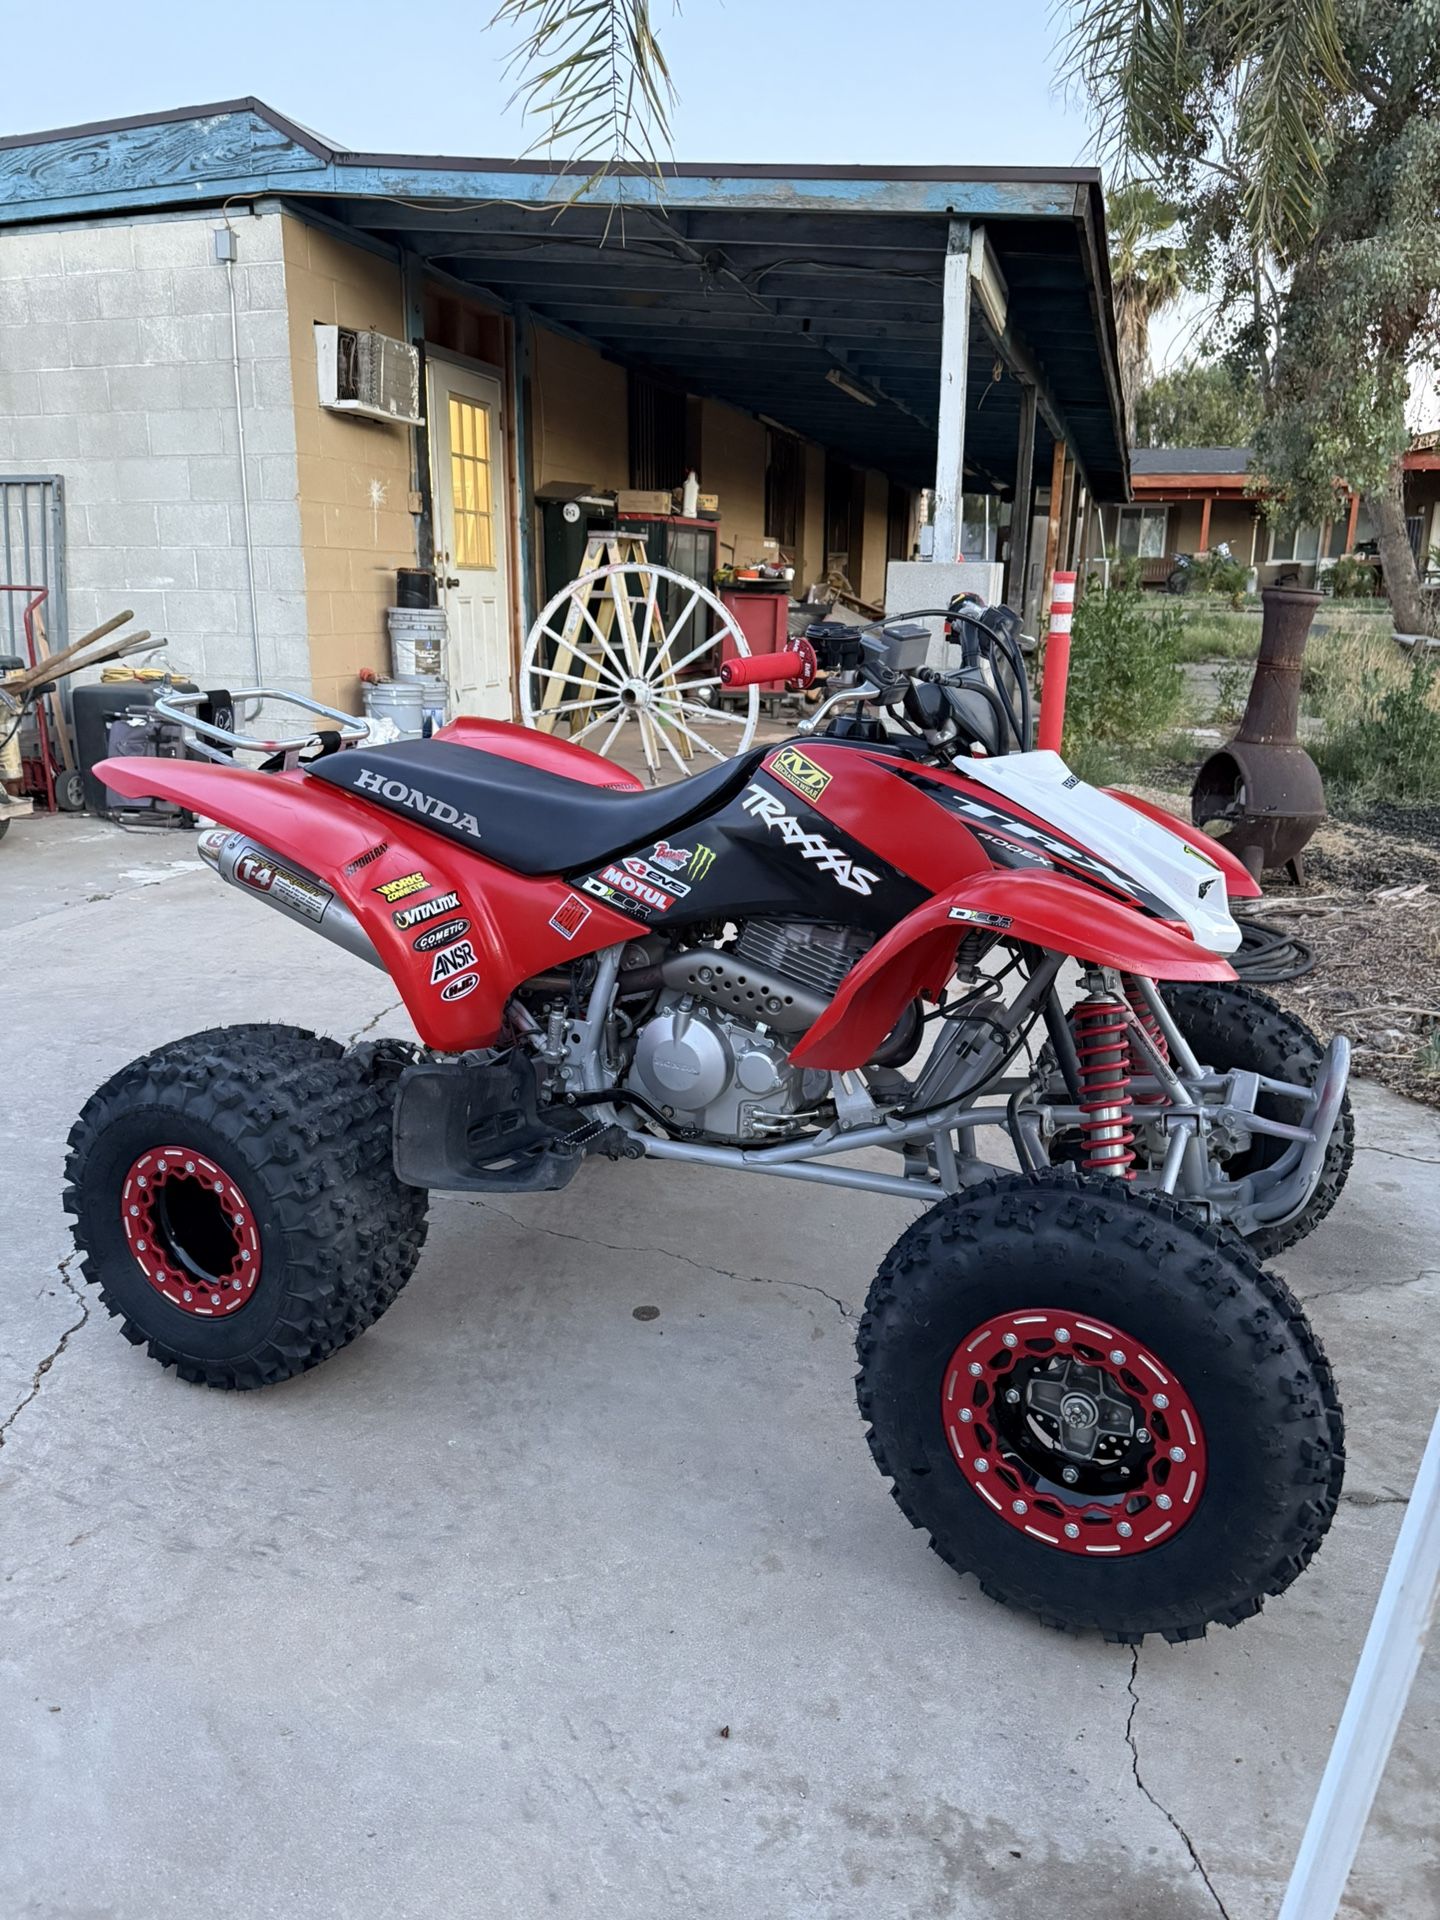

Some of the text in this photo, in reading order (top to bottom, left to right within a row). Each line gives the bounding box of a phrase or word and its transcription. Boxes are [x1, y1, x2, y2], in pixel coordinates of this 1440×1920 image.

[353, 768, 482, 838] HONDA
[799, 781, 819, 799] WEAR
[741, 783, 881, 896] TRAXXAS
[977, 832, 1054, 867] 400EX
[376, 872, 424, 895] WORKS
[387, 881, 431, 902] CONNECTION
[603, 867, 670, 910] MOTUL
[420, 922, 464, 947] COMETIC
[433, 942, 475, 981] ANSR
[448, 976, 474, 997] HJC
